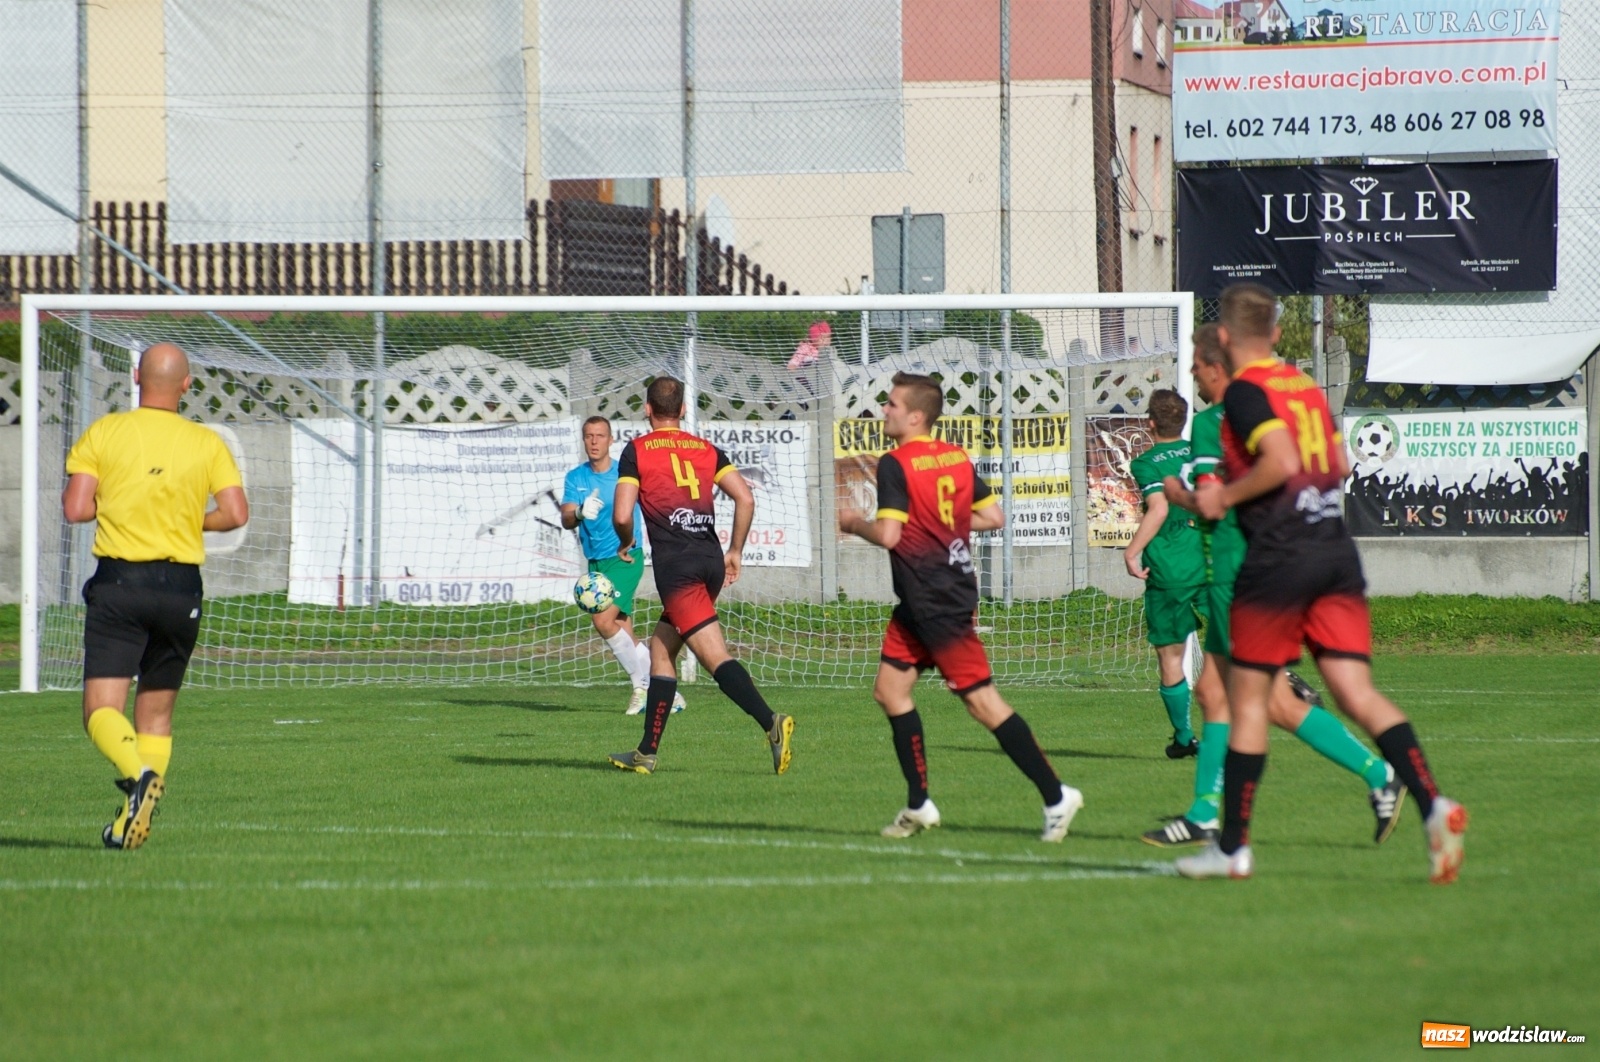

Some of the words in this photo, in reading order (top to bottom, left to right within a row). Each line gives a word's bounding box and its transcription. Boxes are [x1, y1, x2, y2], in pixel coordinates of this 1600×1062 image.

[1304, 9, 1549, 38] RESTAURACJA
[1184, 61, 1547, 92] www.restauracjabravo.com.pl
[1185, 119, 1218, 139] tel.
[1226, 118, 1264, 138] 602
[1272, 116, 1310, 136] 744
[1319, 115, 1362, 136] 173,
[1370, 113, 1397, 133] 48
[1404, 112, 1443, 132] 606
[1451, 111, 1477, 130] 27
[1484, 109, 1511, 129] 08
[1519, 108, 1545, 128] 98
[1324, 230, 1403, 243] POŚPIECH
[1403, 422, 1451, 437] JEDEN
[1457, 422, 1476, 437] ZA
[1481, 421, 1578, 437] WSZYSTKICH
[1406, 442, 1477, 457] WSZYSCY
[1482, 442, 1500, 457] ZA
[1506, 441, 1576, 457] JEDNEGO
[670, 452, 700, 500] 4
[937, 474, 956, 532] 6
[1036, 501, 1070, 509] PAWLIK
[1018, 513, 1037, 524] 419
[1040, 512, 1053, 523] 62
[1056, 512, 1070, 522] 99
[1463, 504, 1569, 525] TWORKÓW
[1059, 526, 1071, 536] 41
[768, 550, 776, 560] 8
[399, 583, 432, 602] 604
[440, 582, 472, 602] 507
[480, 582, 513, 602] 320
